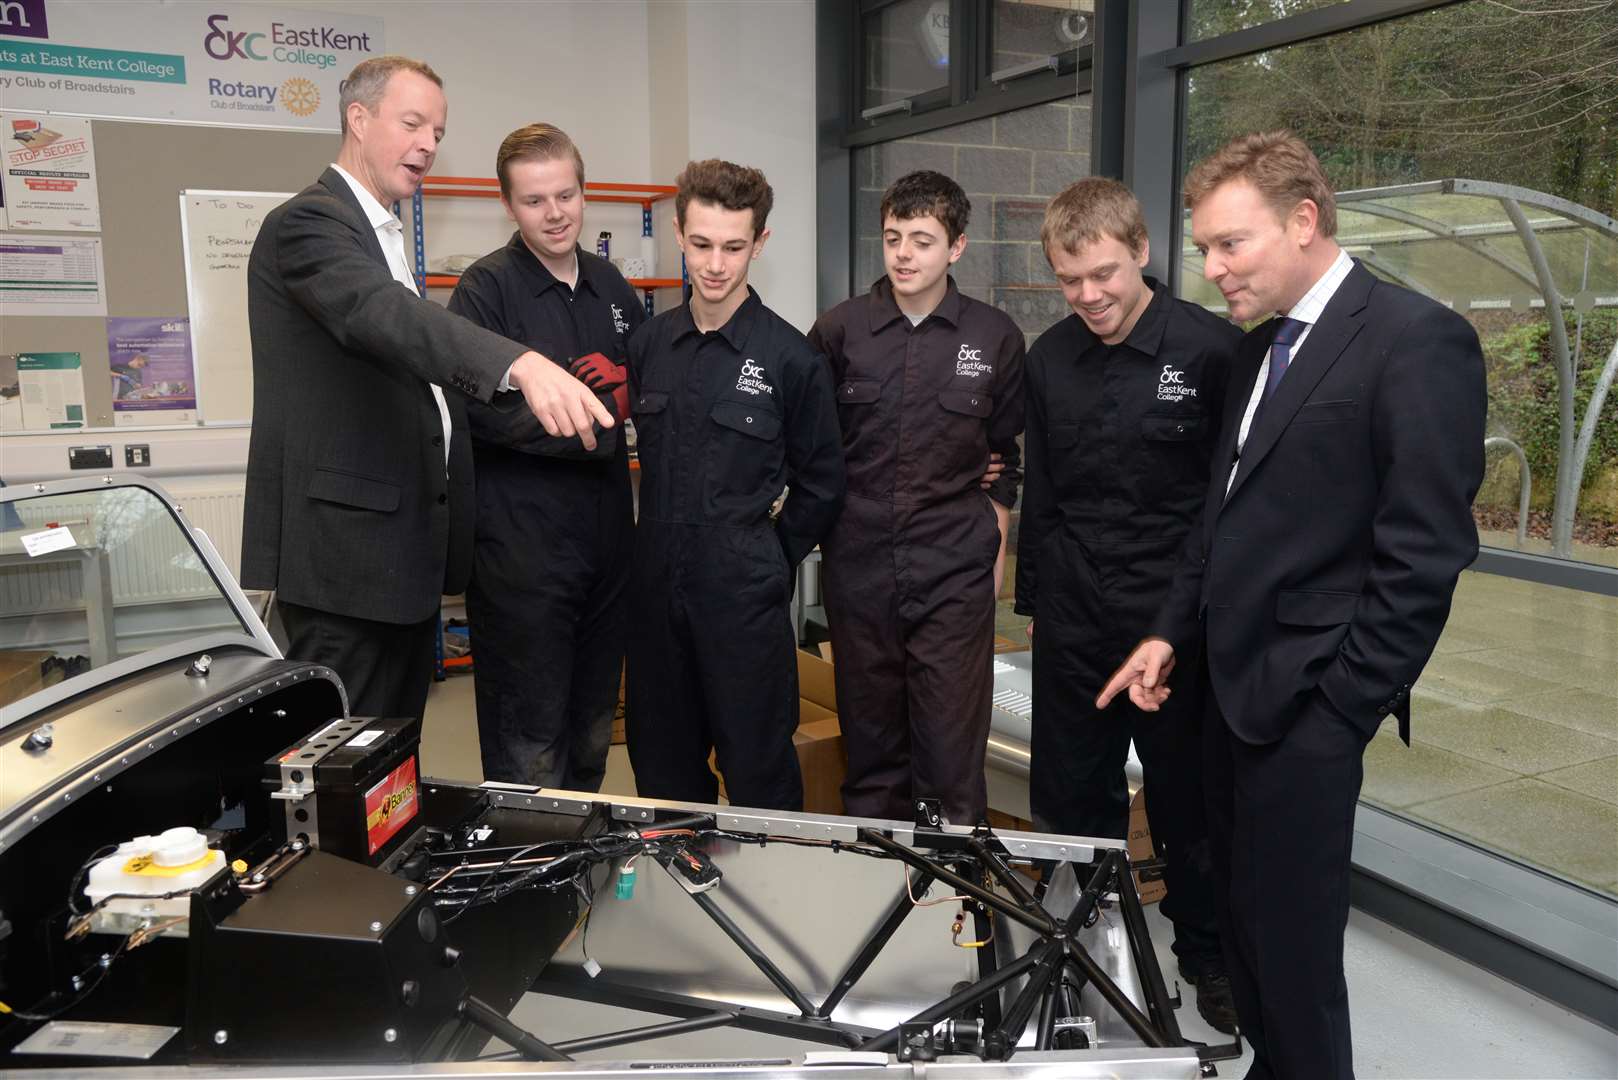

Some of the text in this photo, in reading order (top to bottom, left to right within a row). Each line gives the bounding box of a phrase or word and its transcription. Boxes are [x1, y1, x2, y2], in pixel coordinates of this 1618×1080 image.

[0, 51, 175, 78] ts at East Kent College
[273, 47, 337, 69] College
[16, 77, 46, 89] Club
[49, 80, 63, 90] of
[65, 81, 136, 96] Broadstairs
[208, 78, 277, 104] Rotary
[211, 100, 275, 112] Club of Broadstairs
[9, 151, 40, 164] STOP
[43, 141, 87, 158] SECRET
[208, 199, 227, 209] To
[955, 368, 980, 378] College
[735, 383, 760, 396] College
[1157, 392, 1184, 402] College
[390, 782, 415, 809] Banner
